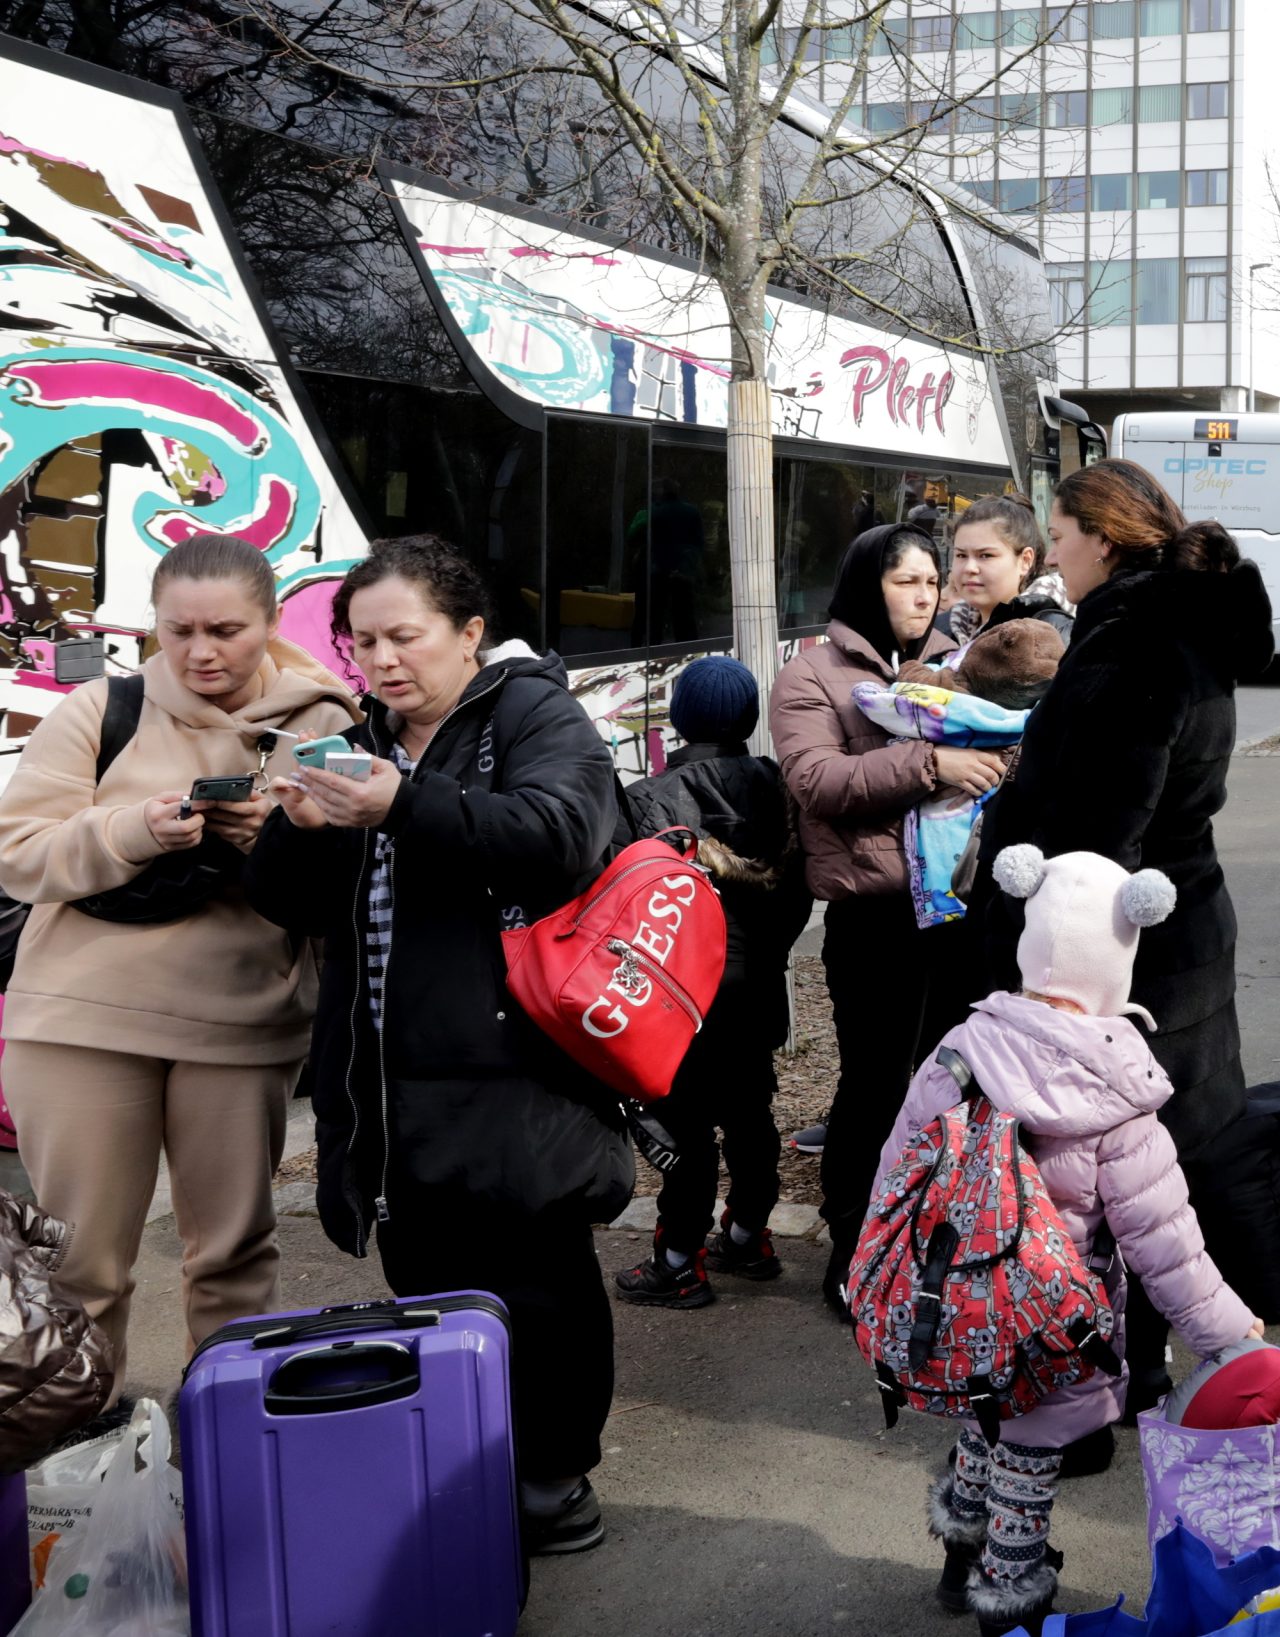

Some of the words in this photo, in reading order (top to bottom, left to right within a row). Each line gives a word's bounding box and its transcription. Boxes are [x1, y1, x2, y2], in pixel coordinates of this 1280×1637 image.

[839, 345, 954, 438] Pletl
[1208, 421, 1230, 440] 511
[1165, 459, 1267, 475] OPITEC
[1193, 468, 1233, 498] Shop
